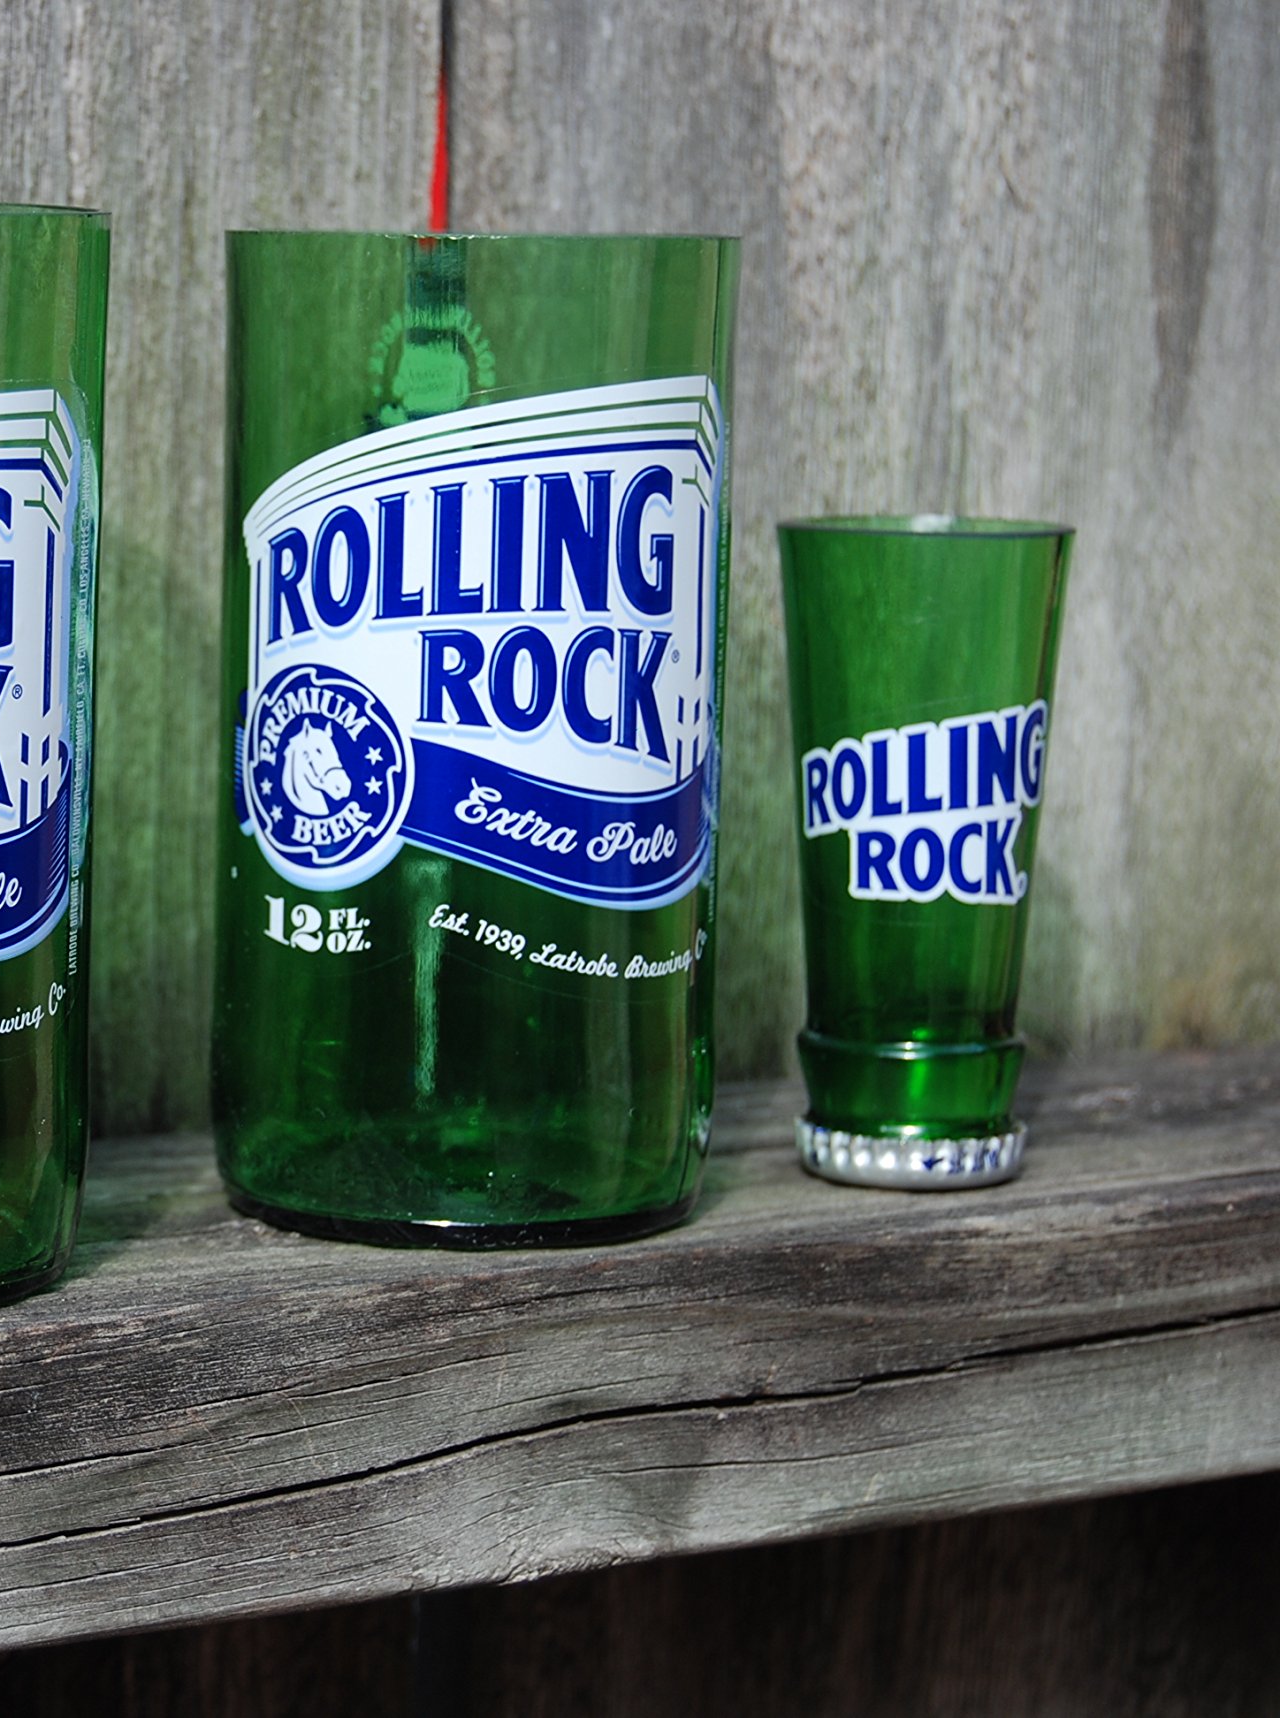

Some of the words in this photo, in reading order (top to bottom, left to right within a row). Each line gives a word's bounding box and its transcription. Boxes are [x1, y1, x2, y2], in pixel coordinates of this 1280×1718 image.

[265, 464, 675, 646] ROLLING
[259, 686, 371, 767] PREMIUM
[417, 625, 673, 764] ROCK
[804, 703, 1046, 833] ROLLING
[291, 800, 372, 846] BEER
[454, 776, 578, 855] Extra
[585, 821, 678, 865] Pale
[854, 816, 1017, 899] ROCK
[263, 894, 324, 953] 12
[328, 907, 371, 931] FL.
[326, 930, 372, 954] OZ.
[428, 903, 470, 936] Est.
[474, 918, 526, 960] 1939,
[528, 942, 619, 978] Latrobe
[623, 950, 694, 982] Brewing
[47, 981, 67, 1017] Co.
